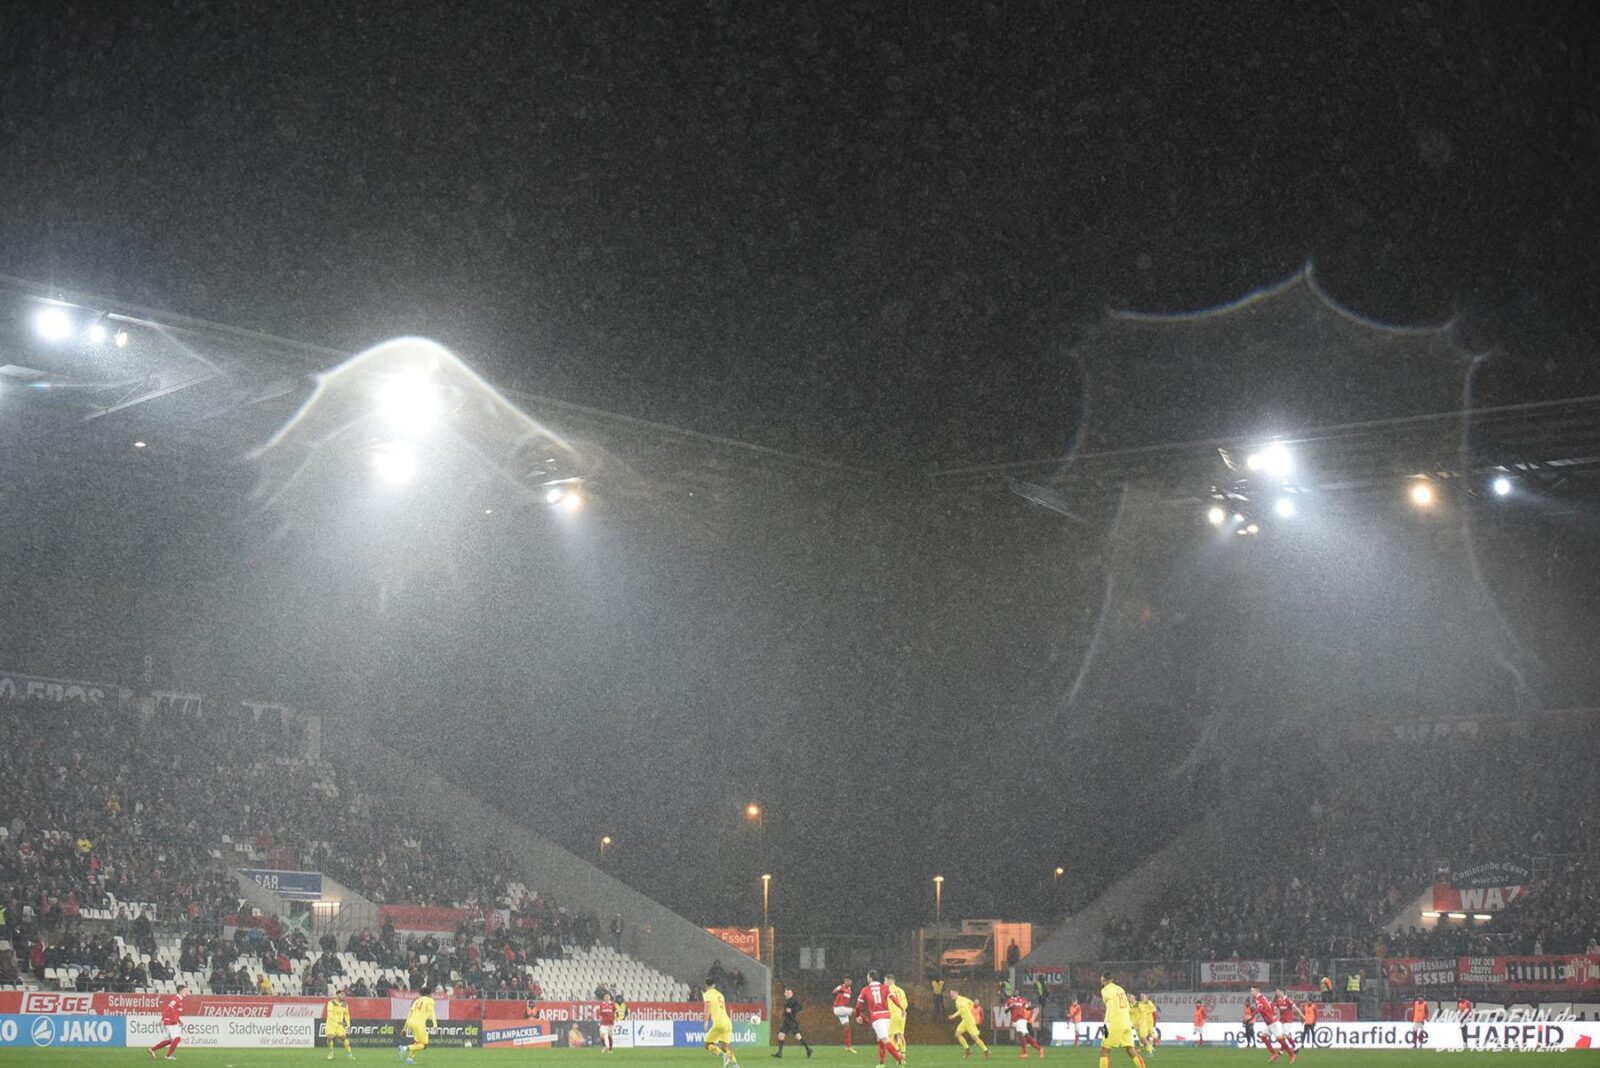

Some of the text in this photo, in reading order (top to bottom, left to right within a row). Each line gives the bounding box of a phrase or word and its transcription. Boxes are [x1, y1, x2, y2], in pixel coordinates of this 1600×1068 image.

[204, 1006, 269, 1018] TRANSPORTE
[538, 1008, 569, 1021] ARFID
[993, 1006, 1040, 1028] WZ
[60, 1020, 113, 1042] JAKO
[229, 1021, 311, 1035] Stadtwerkessen
[486, 1031, 500, 1041] DER
[1462, 1025, 1564, 1047] HARFID
